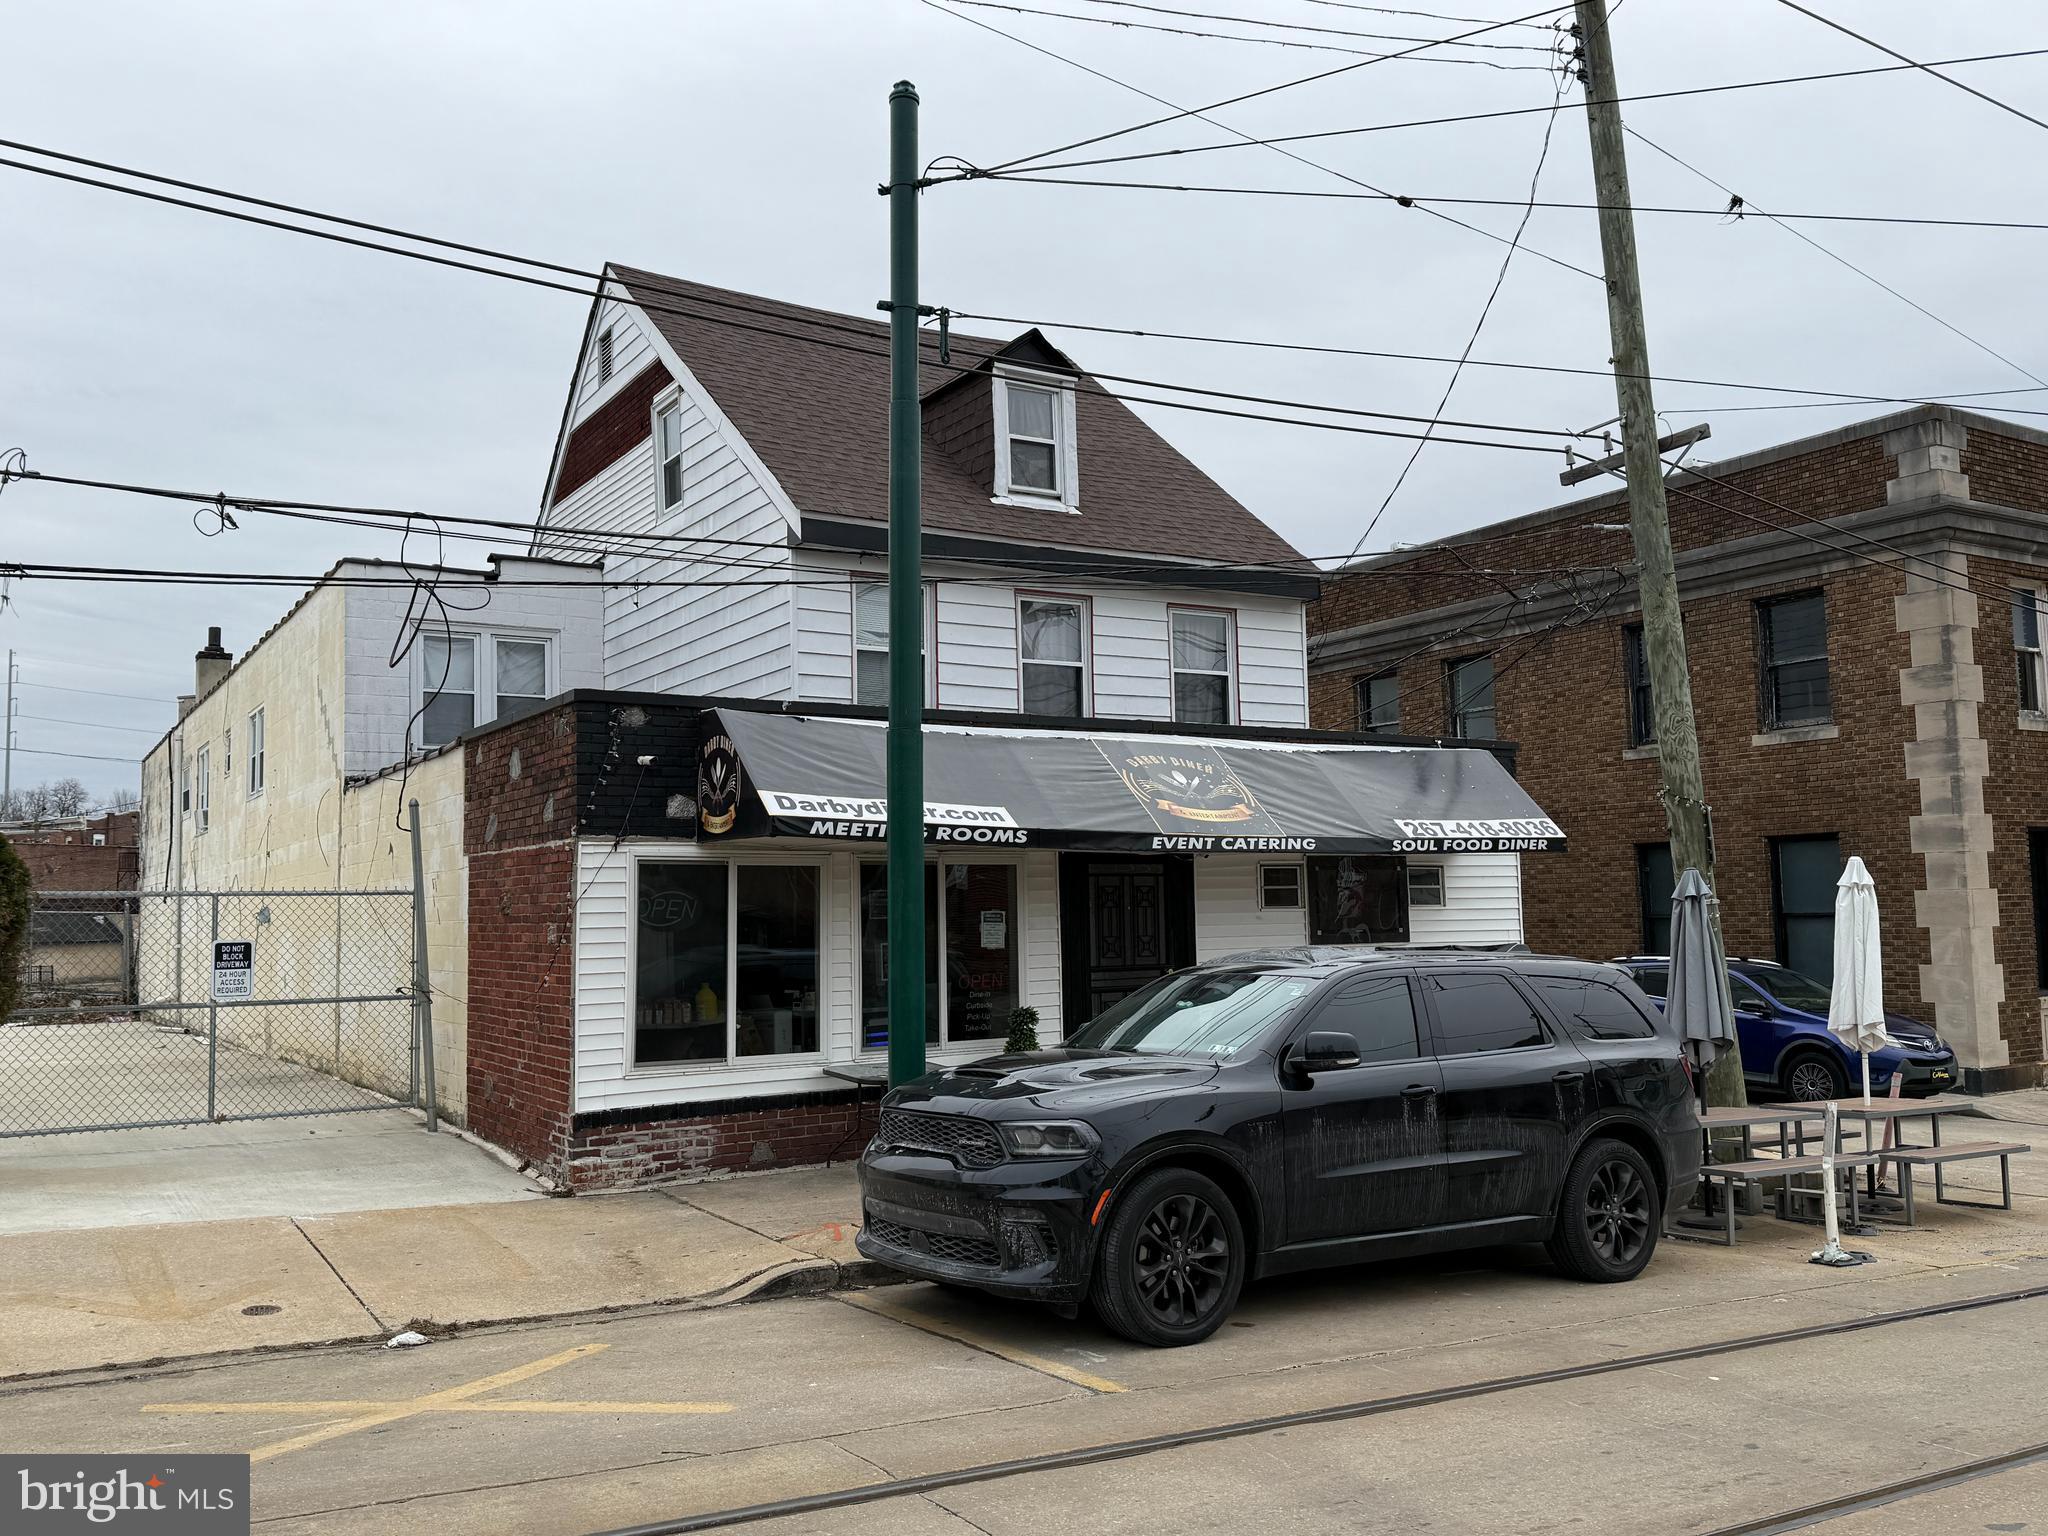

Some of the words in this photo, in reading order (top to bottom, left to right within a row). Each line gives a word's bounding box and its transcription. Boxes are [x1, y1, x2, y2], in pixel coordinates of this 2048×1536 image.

[1125, 755, 1167, 768] DARBY
[1169, 756, 1213, 774] DINER
[774, 795, 1005, 823] Darbydir.com
[809, 820, 928, 839] MEETI
[936, 827, 1028, 844] ROOMS
[1403, 820, 1559, 837] 267-418-8036
[1152, 836, 1215, 850] EVENT
[1221, 837, 1317, 850] CATERING
[1392, 839, 1438, 851] SOUL
[1443, 839, 1493, 850] FOOD
[1498, 839, 1548, 850] DINER
[640, 898, 697, 920] OPEN
[216, 986, 248, 994] REQUIRED
[959, 974, 1003, 989] OPEN
